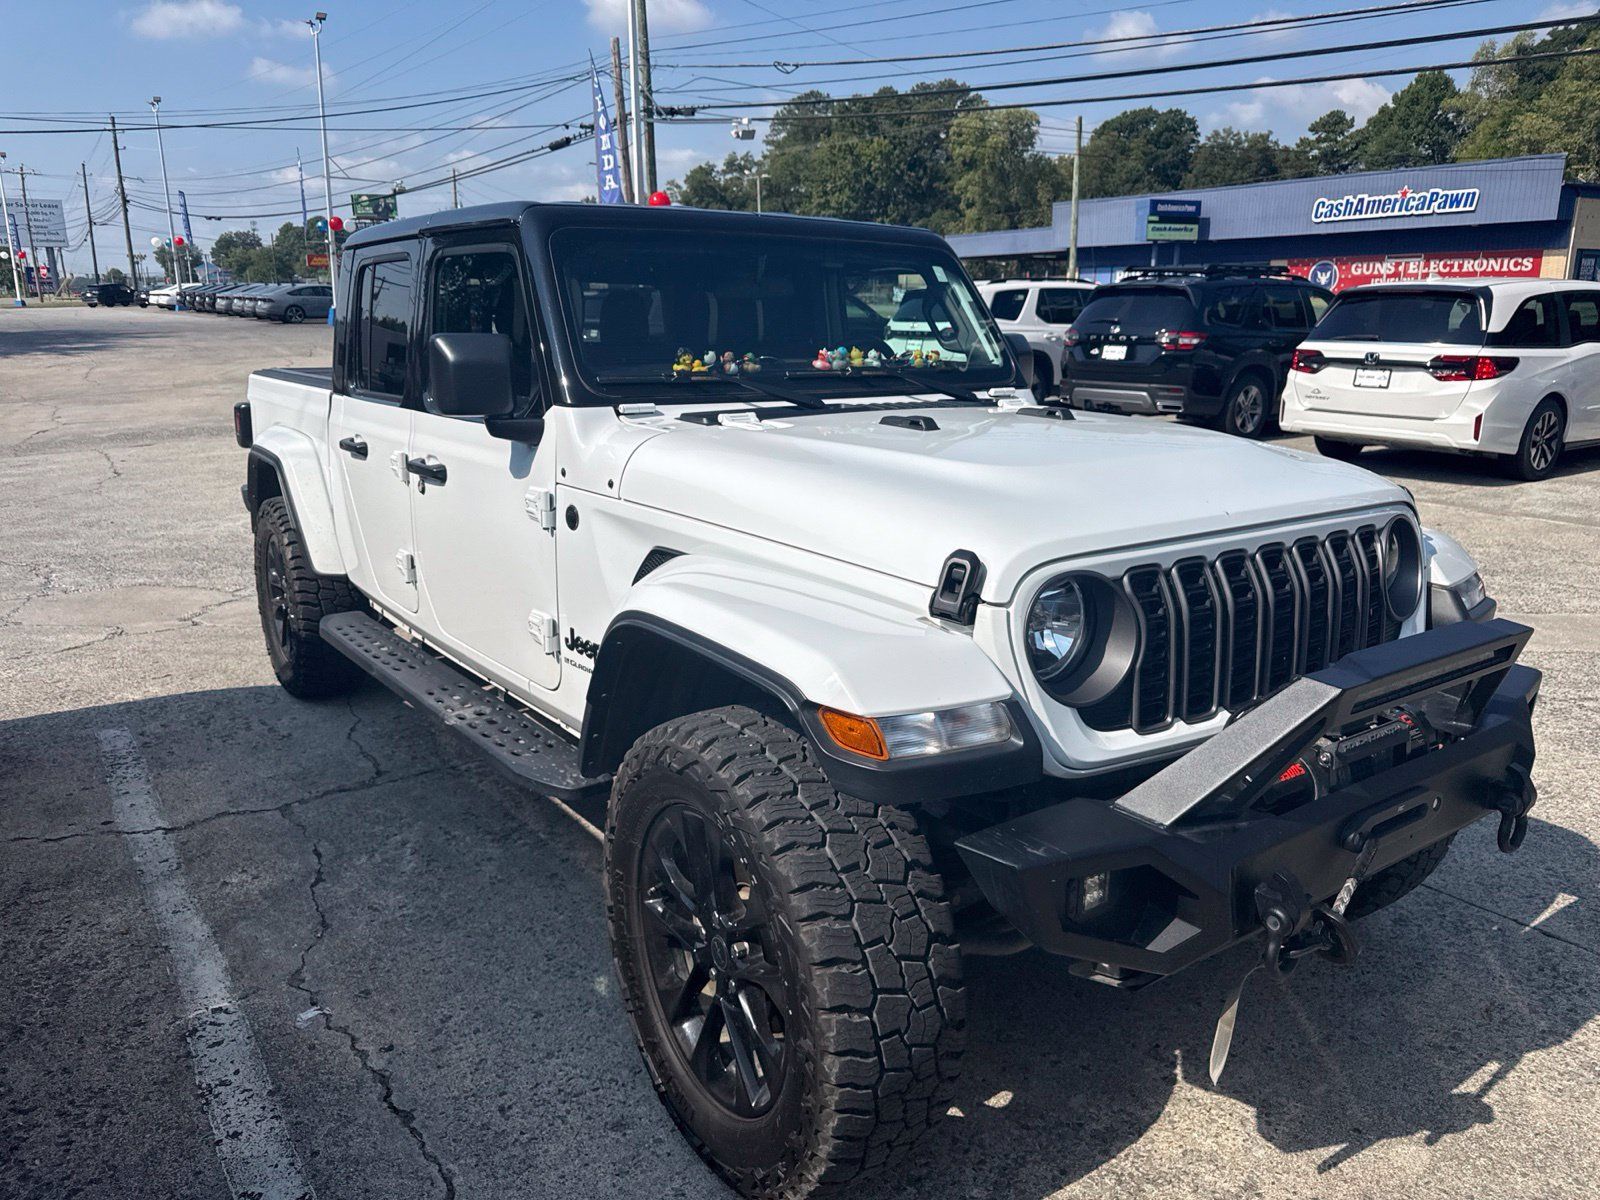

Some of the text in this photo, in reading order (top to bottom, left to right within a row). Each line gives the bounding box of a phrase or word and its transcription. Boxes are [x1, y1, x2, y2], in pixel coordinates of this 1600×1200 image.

[1351, 257, 1534, 276] GUNS ELECTRONICS
[1089, 334, 1139, 342] PILOT
[565, 627, 600, 659] Jeep
